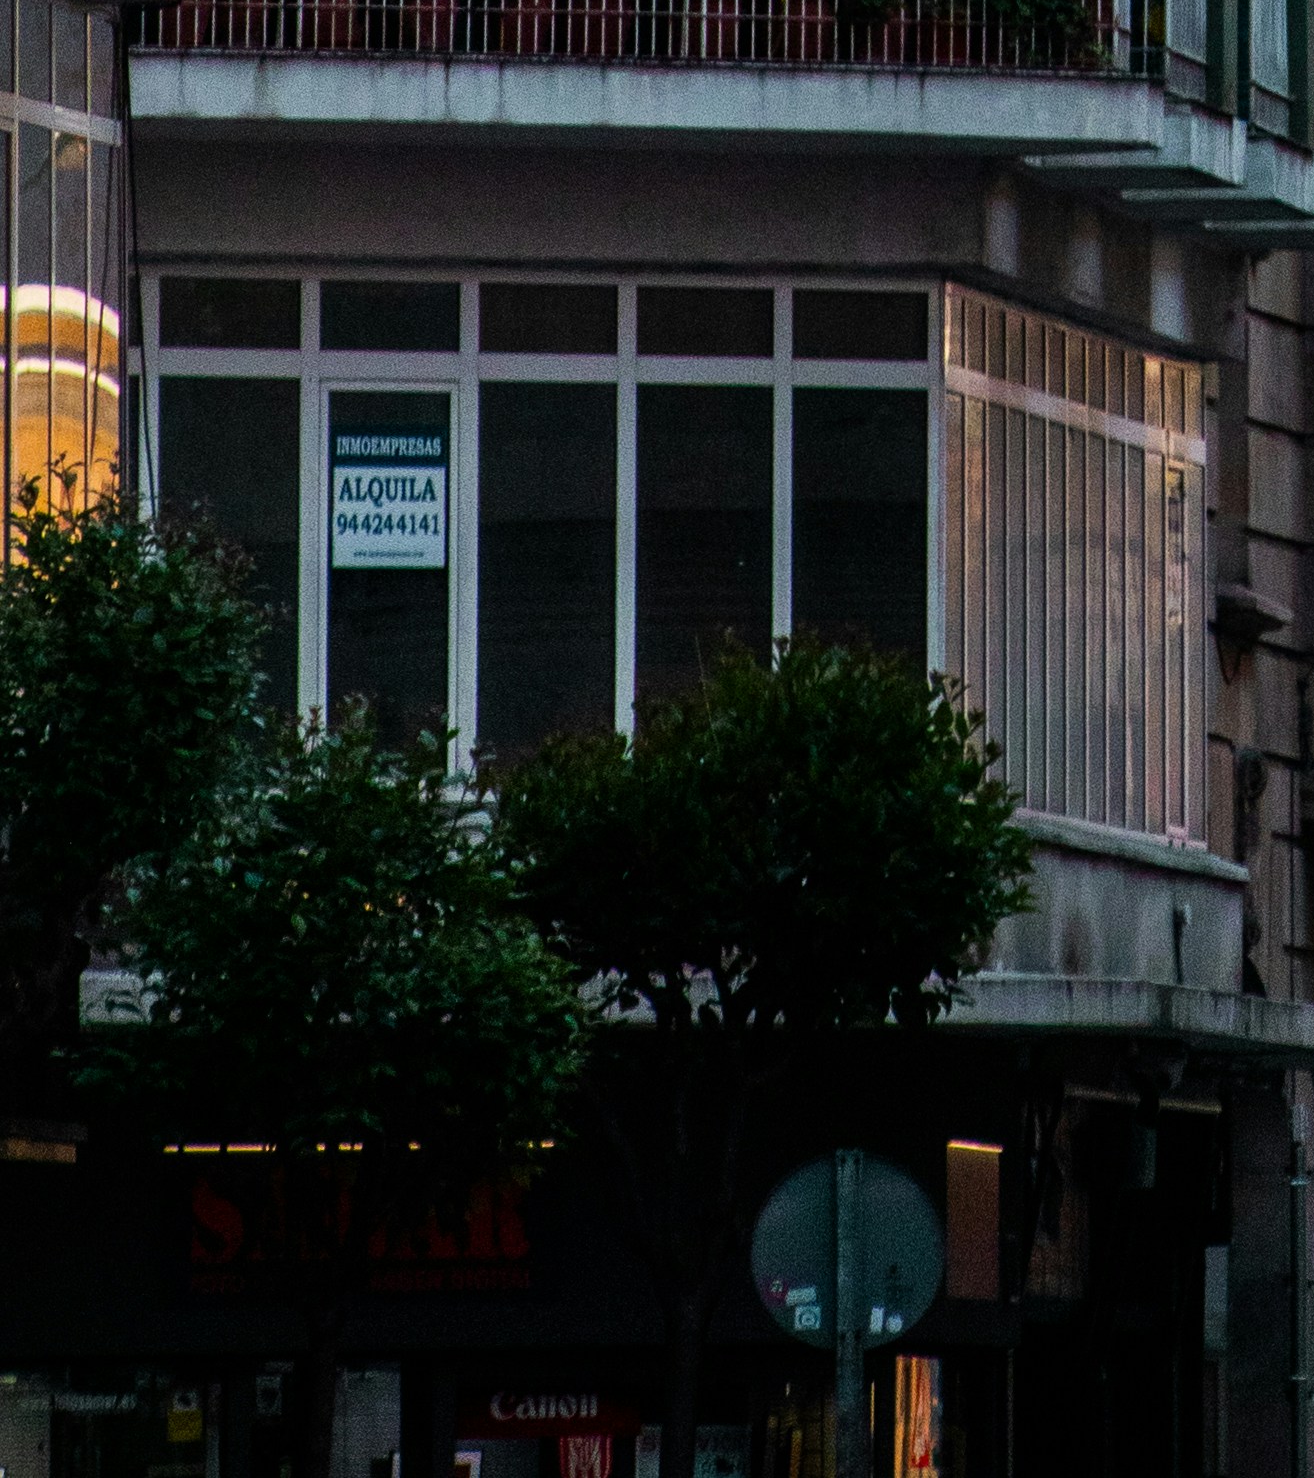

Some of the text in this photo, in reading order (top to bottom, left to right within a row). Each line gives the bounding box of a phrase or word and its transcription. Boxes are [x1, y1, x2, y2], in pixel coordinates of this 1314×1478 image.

[336, 436, 442, 456] INMOEMPRESAS
[339, 477, 437, 507] ALQUILA
[337, 513, 440, 535] 944244141
[489, 1390, 599, 1420] Canon
